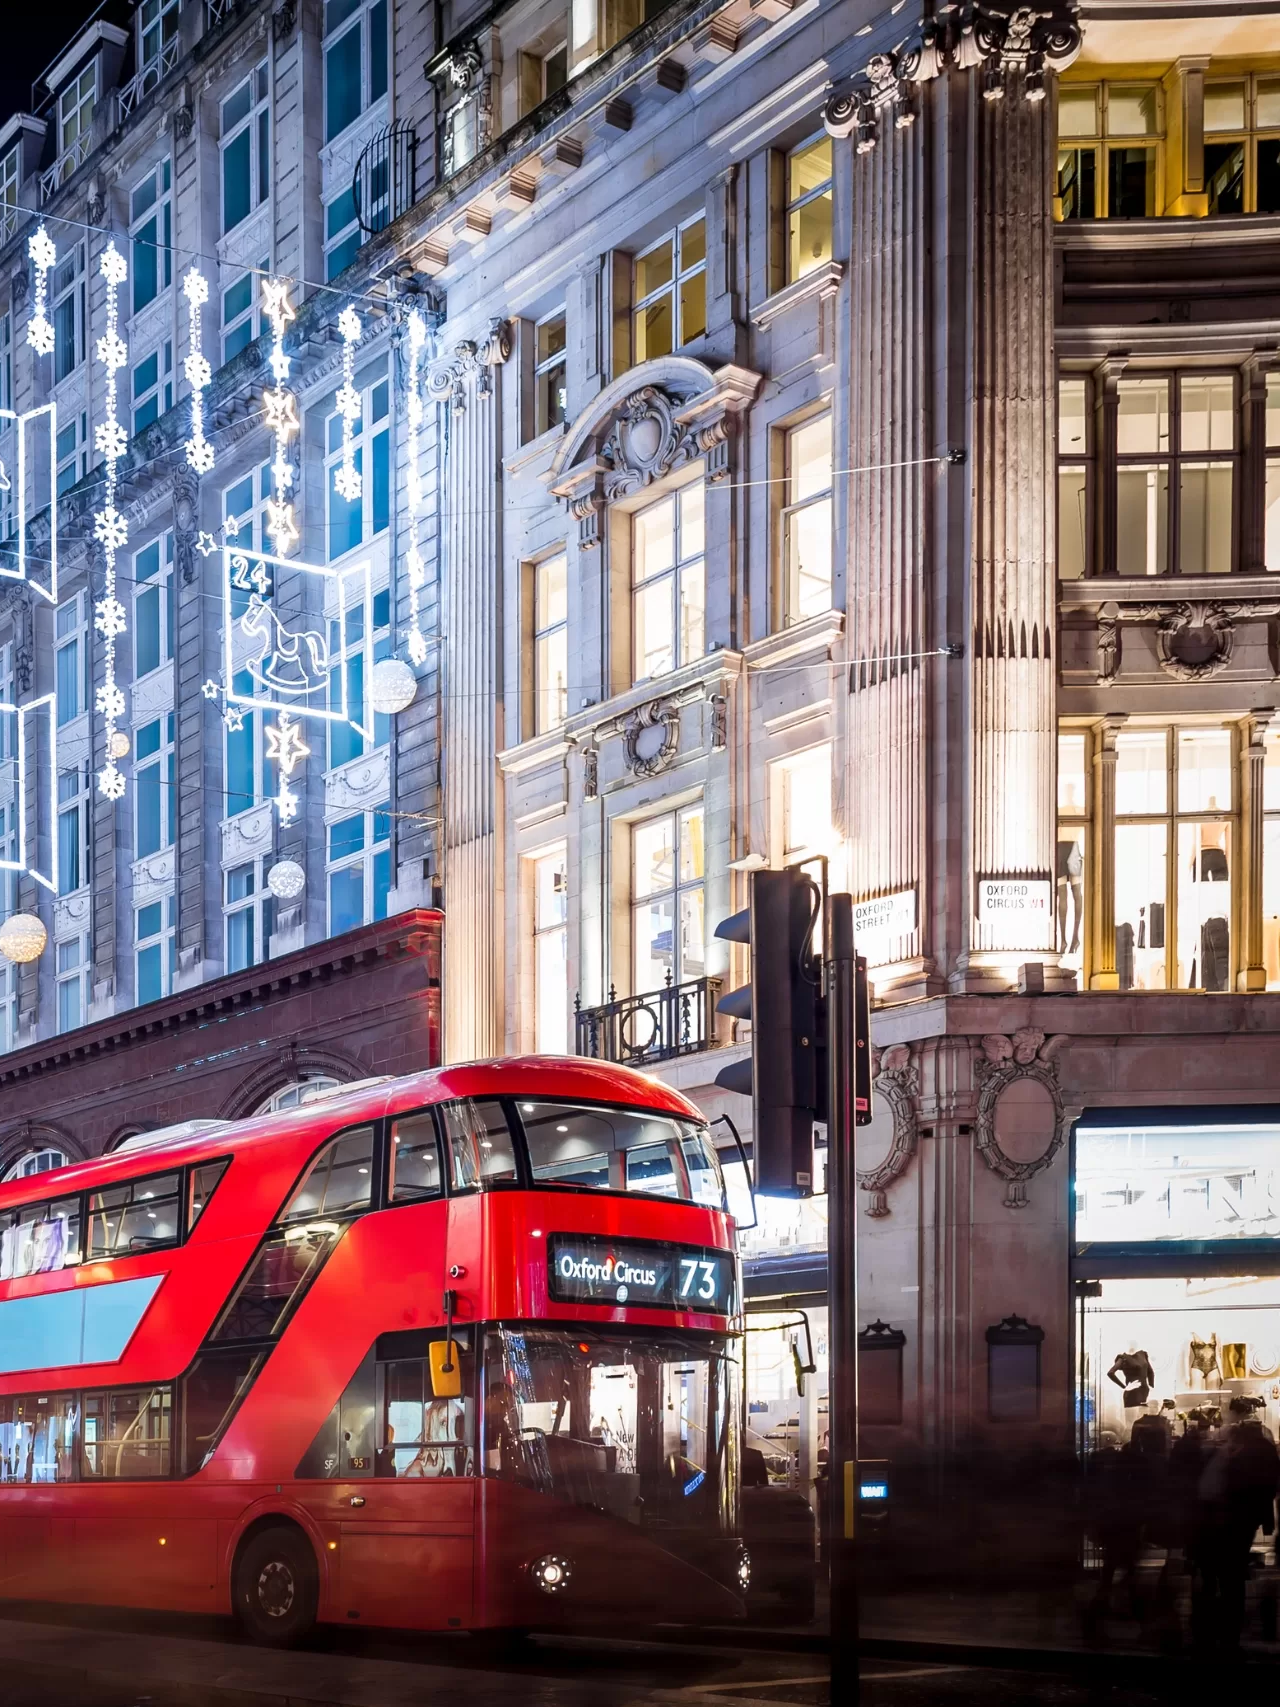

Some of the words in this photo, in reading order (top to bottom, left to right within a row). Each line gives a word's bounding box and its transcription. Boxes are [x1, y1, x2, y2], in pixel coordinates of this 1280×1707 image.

[231, 555, 272, 594] 24
[986, 885, 1028, 896] OXFORD
[856, 900, 894, 919] OXFORD
[986, 897, 1025, 909] CIRCUS
[856, 912, 891, 932] STREET
[560, 1254, 610, 1281] Oxford
[613, 1260, 657, 1286] Circus
[680, 1259, 716, 1299] 73
